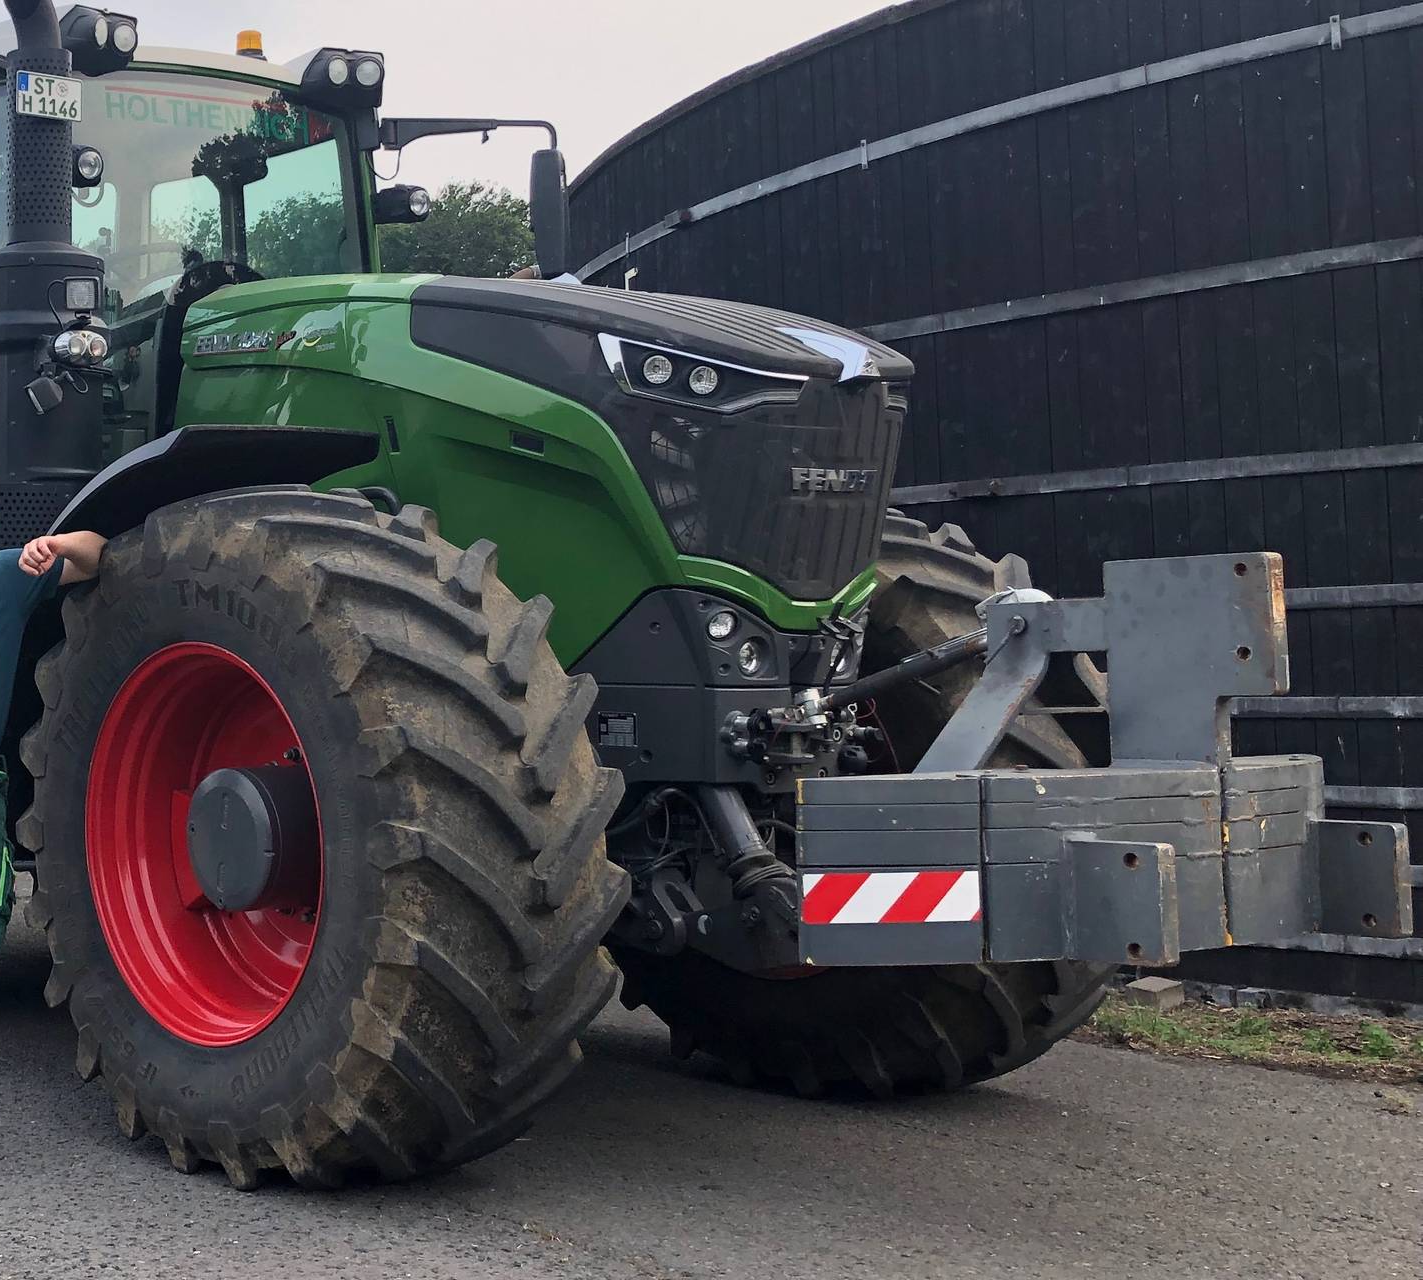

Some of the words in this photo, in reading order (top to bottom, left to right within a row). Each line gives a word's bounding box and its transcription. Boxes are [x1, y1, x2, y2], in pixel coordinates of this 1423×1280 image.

[34, 76, 55, 96] ST
[22, 93, 33, 112] H
[38, 97, 77, 118] 1146
[790, 466, 878, 492] FENDT
